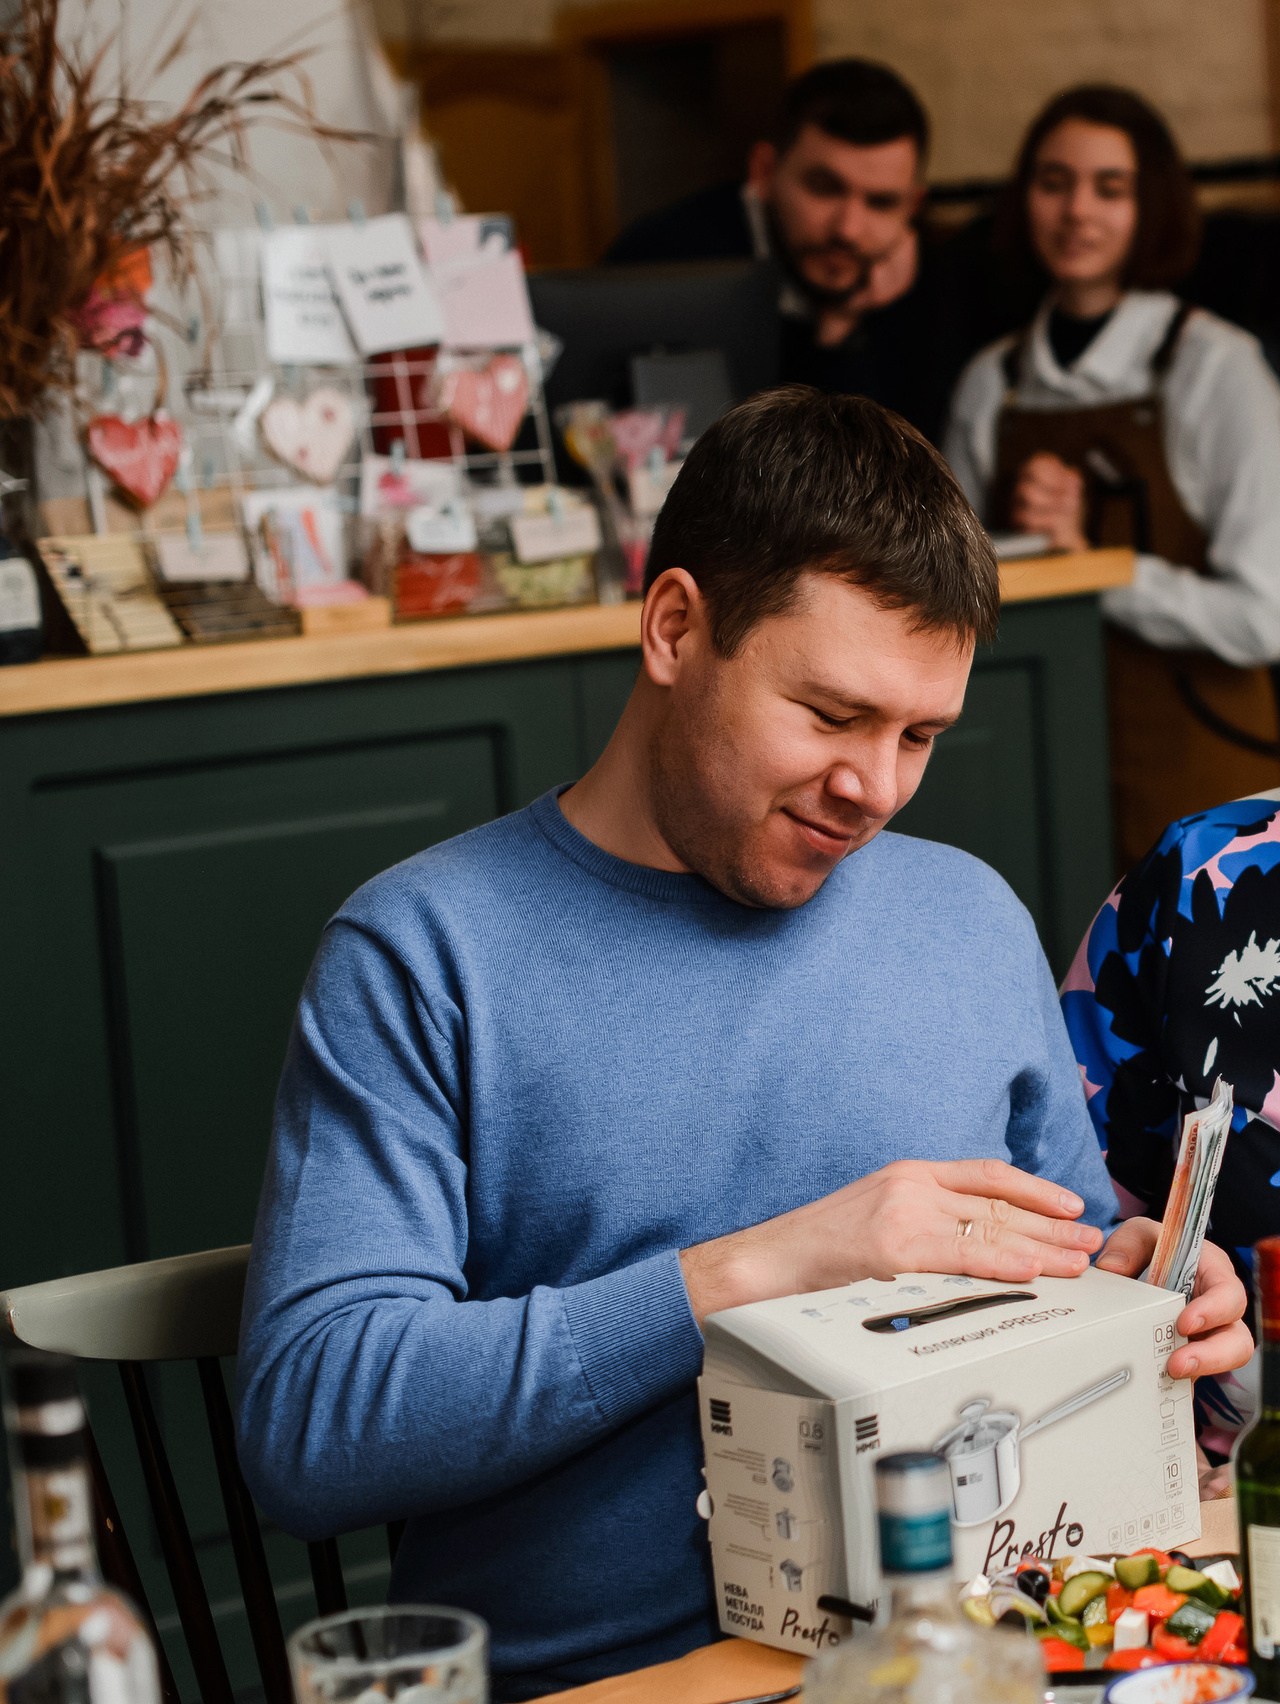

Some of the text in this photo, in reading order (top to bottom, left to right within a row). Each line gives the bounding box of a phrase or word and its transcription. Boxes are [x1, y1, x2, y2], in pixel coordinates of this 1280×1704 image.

[907, 1307, 1076, 1358] Коллекция «PRESTO»
[1155, 1324, 1174, 1343] 0.8
[1166, 1463, 1179, 1479] 10
[982, 1502, 1084, 1577] Presto
[780, 1606, 841, 1650] Presto
